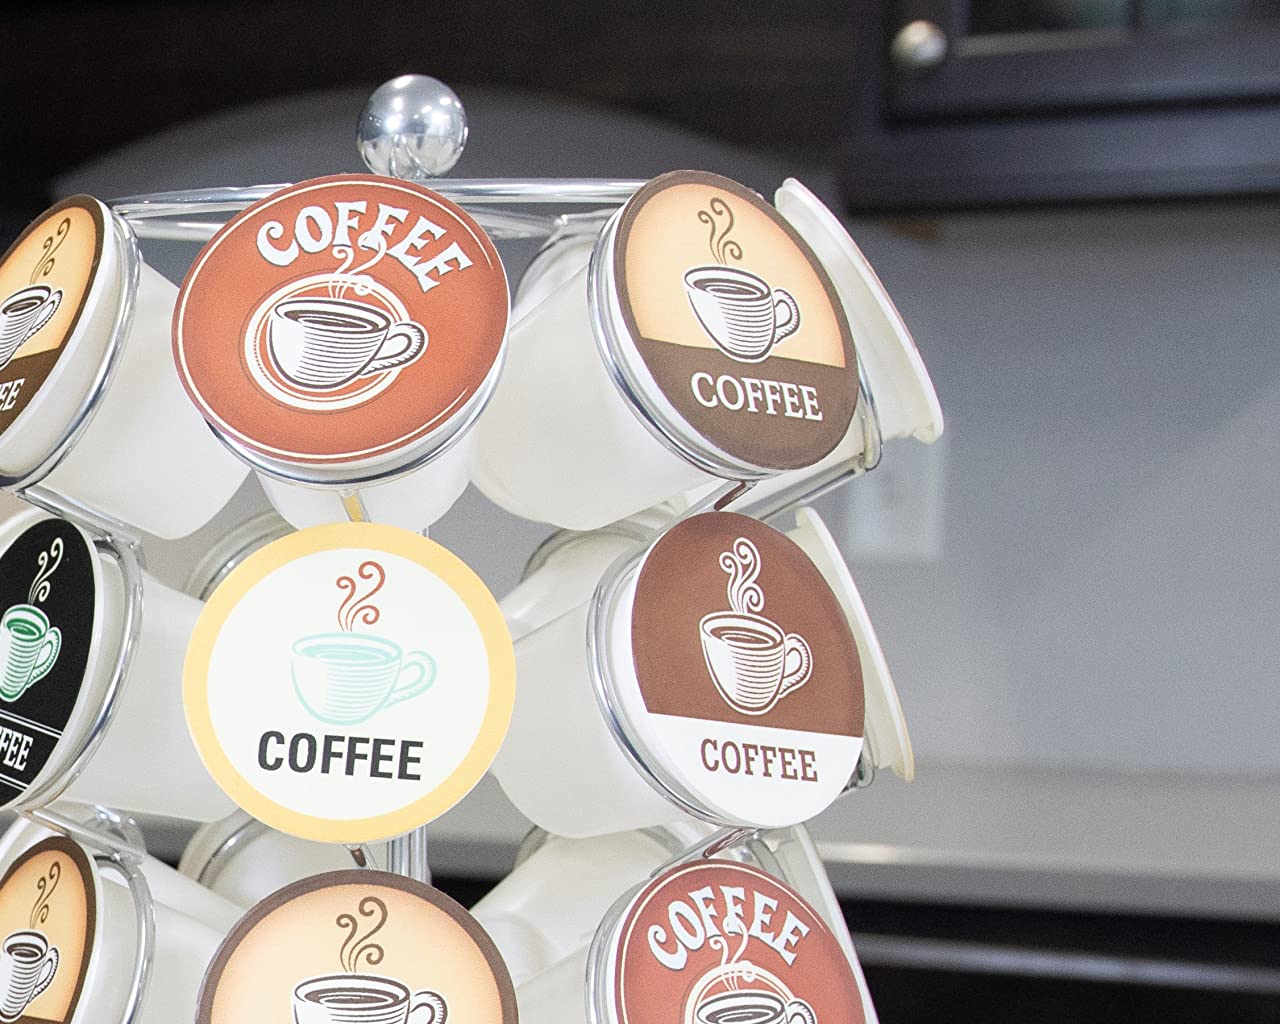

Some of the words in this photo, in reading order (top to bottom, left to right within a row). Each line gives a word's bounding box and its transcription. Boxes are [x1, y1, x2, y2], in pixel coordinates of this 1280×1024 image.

[256, 201, 473, 292] COFFEE
[691, 372, 823, 422] COFFEE
[257, 730, 424, 781] COFFEE
[700, 738, 818, 782] COFFEE
[647, 885, 810, 970] COFFEE
